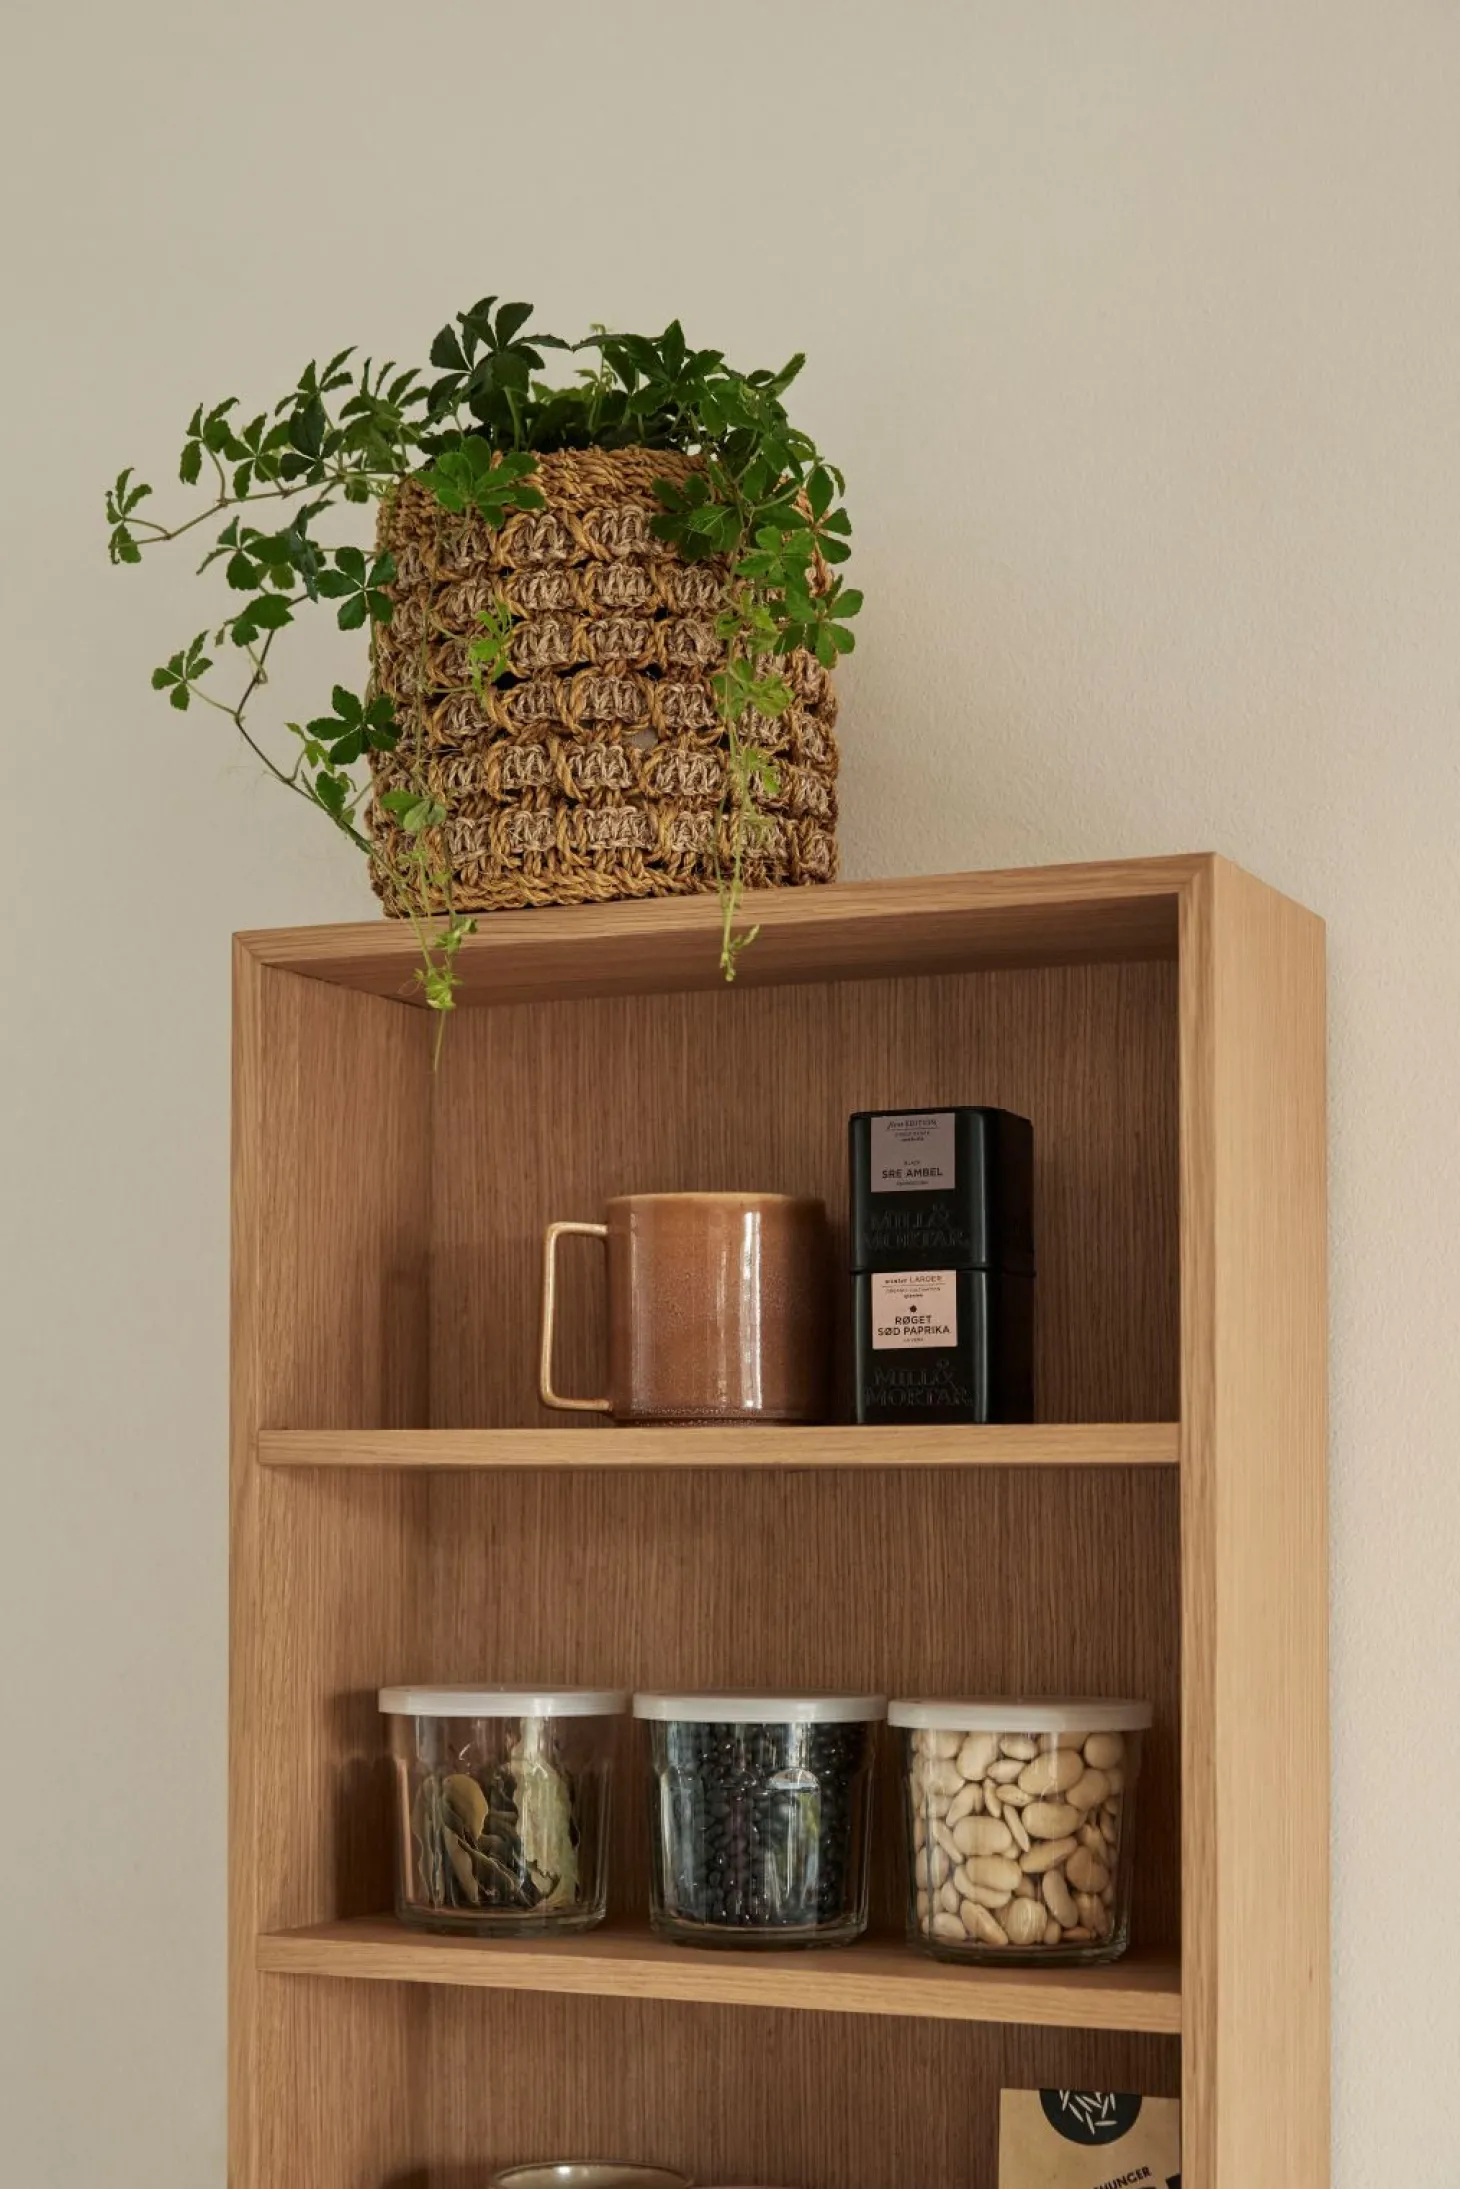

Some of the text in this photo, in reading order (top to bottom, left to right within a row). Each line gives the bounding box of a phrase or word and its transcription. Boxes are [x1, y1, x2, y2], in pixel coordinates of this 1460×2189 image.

[906, 1167, 944, 1179] AMBEL
[895, 1315, 932, 1326] RØGET
[877, 1325, 951, 1337] SØD PAPRIKA
